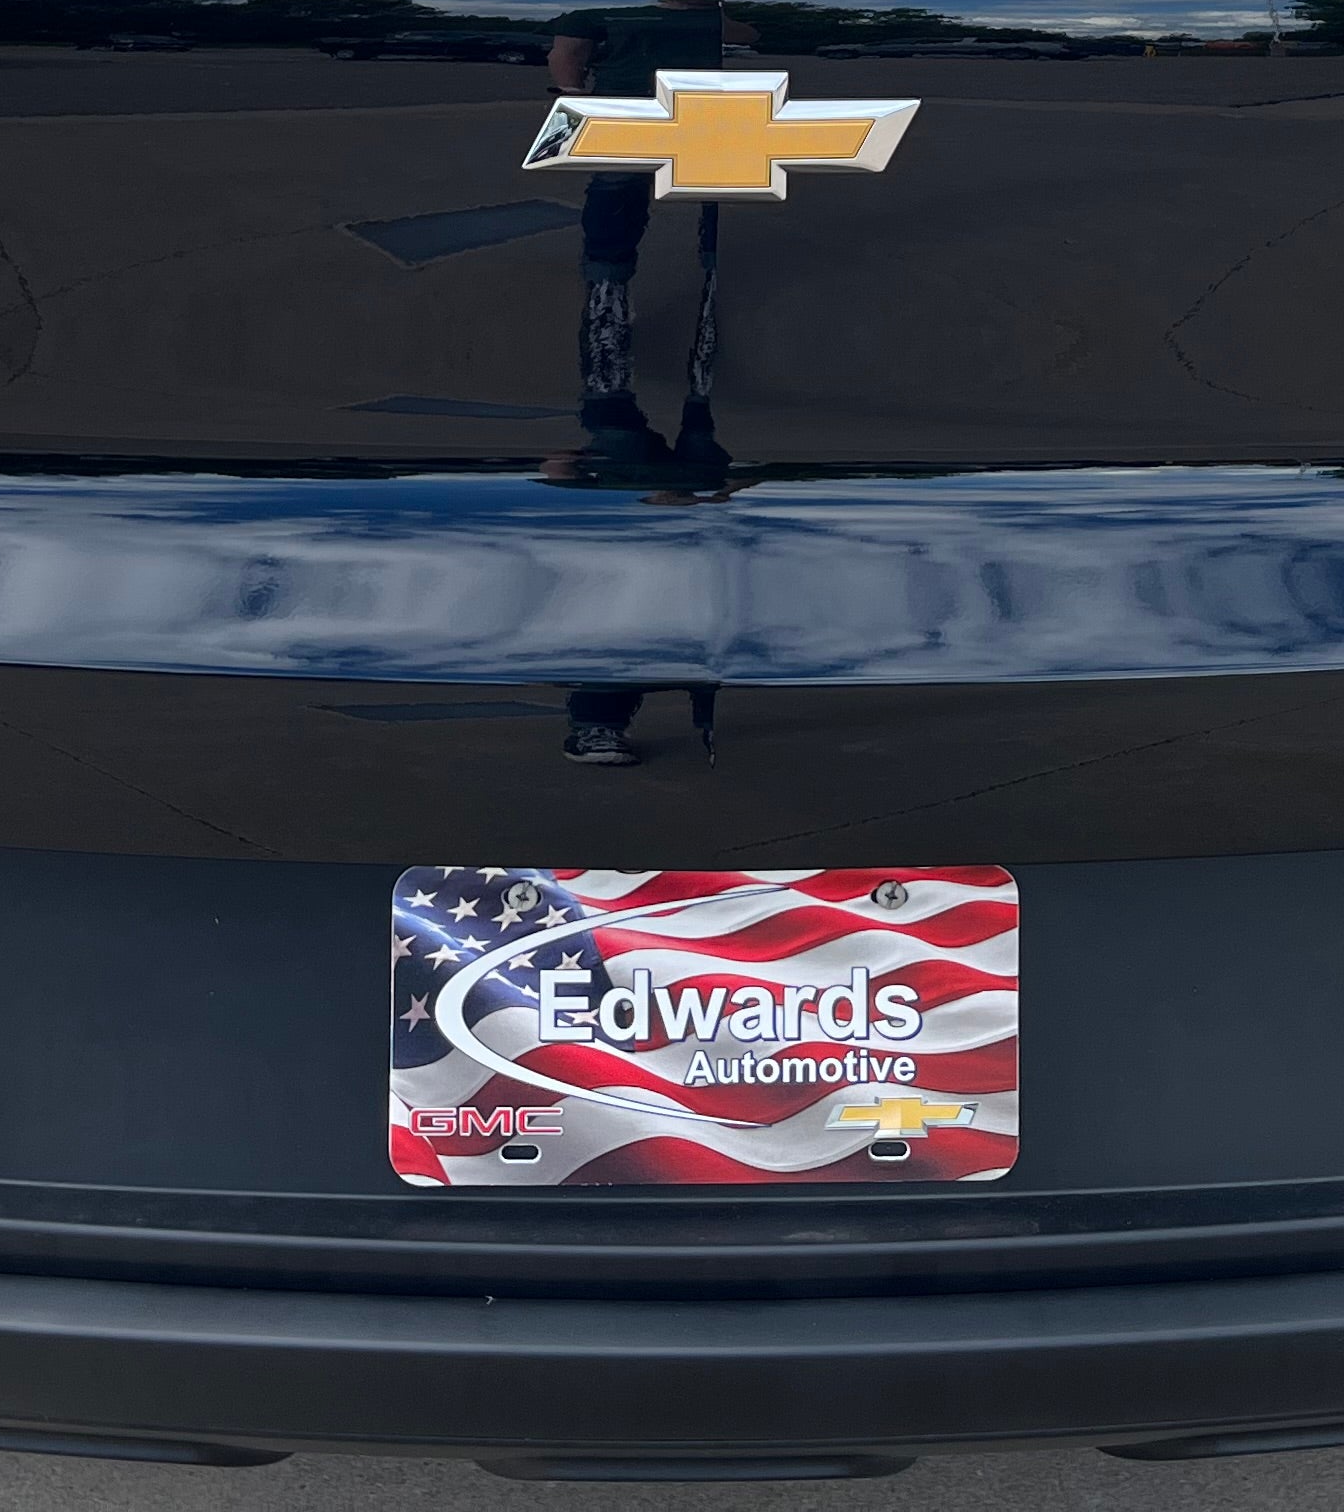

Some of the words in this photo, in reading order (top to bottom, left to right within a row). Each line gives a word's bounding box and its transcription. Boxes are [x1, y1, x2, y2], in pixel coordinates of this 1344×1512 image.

[537, 966, 923, 1045] Edwards
[684, 1049, 917, 1086] Automotive
[408, 1105, 566, 1138] GMC
